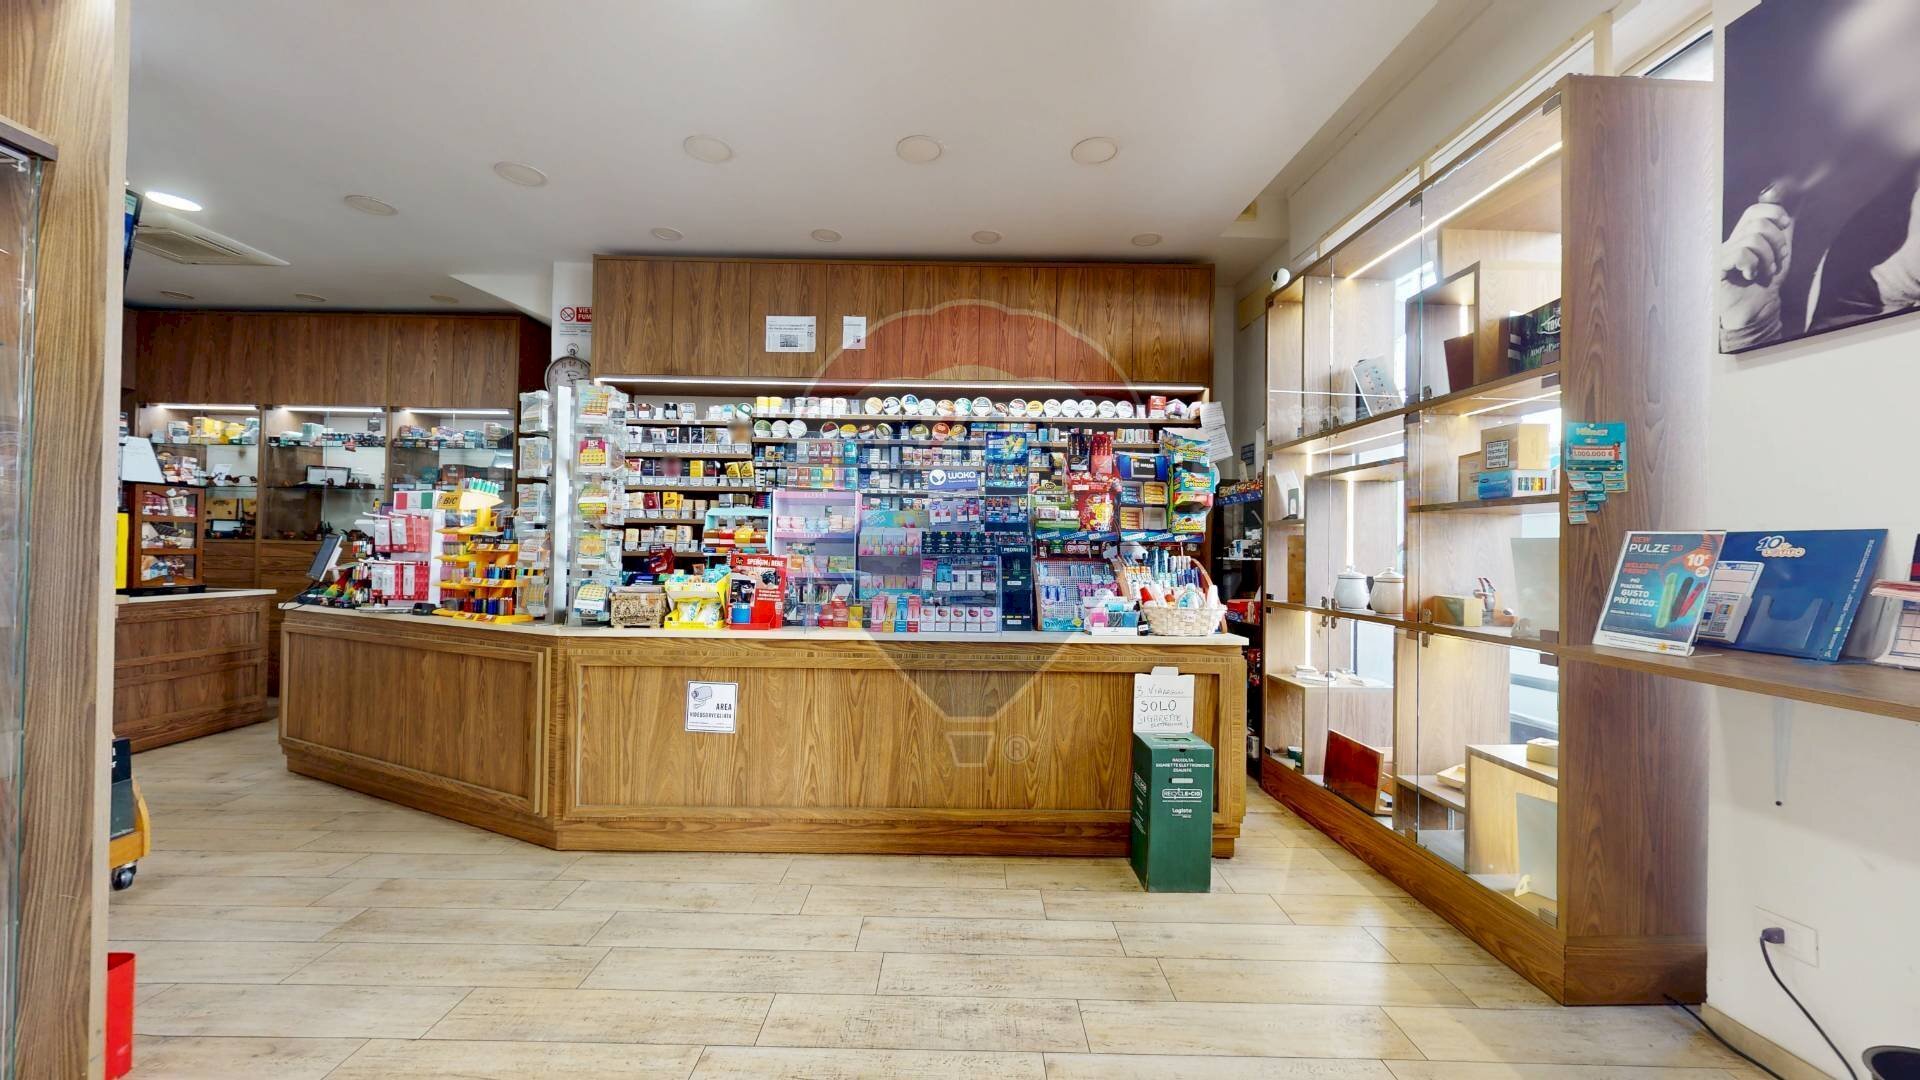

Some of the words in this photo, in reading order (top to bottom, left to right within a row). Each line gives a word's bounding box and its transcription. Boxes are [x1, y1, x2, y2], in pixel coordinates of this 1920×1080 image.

[1629, 543, 1670, 553] PULZE
[1621, 589, 1650, 598] GUSTO
[1613, 595, 1629, 604] PIÙ
[1140, 699, 1177, 713] SOLO
